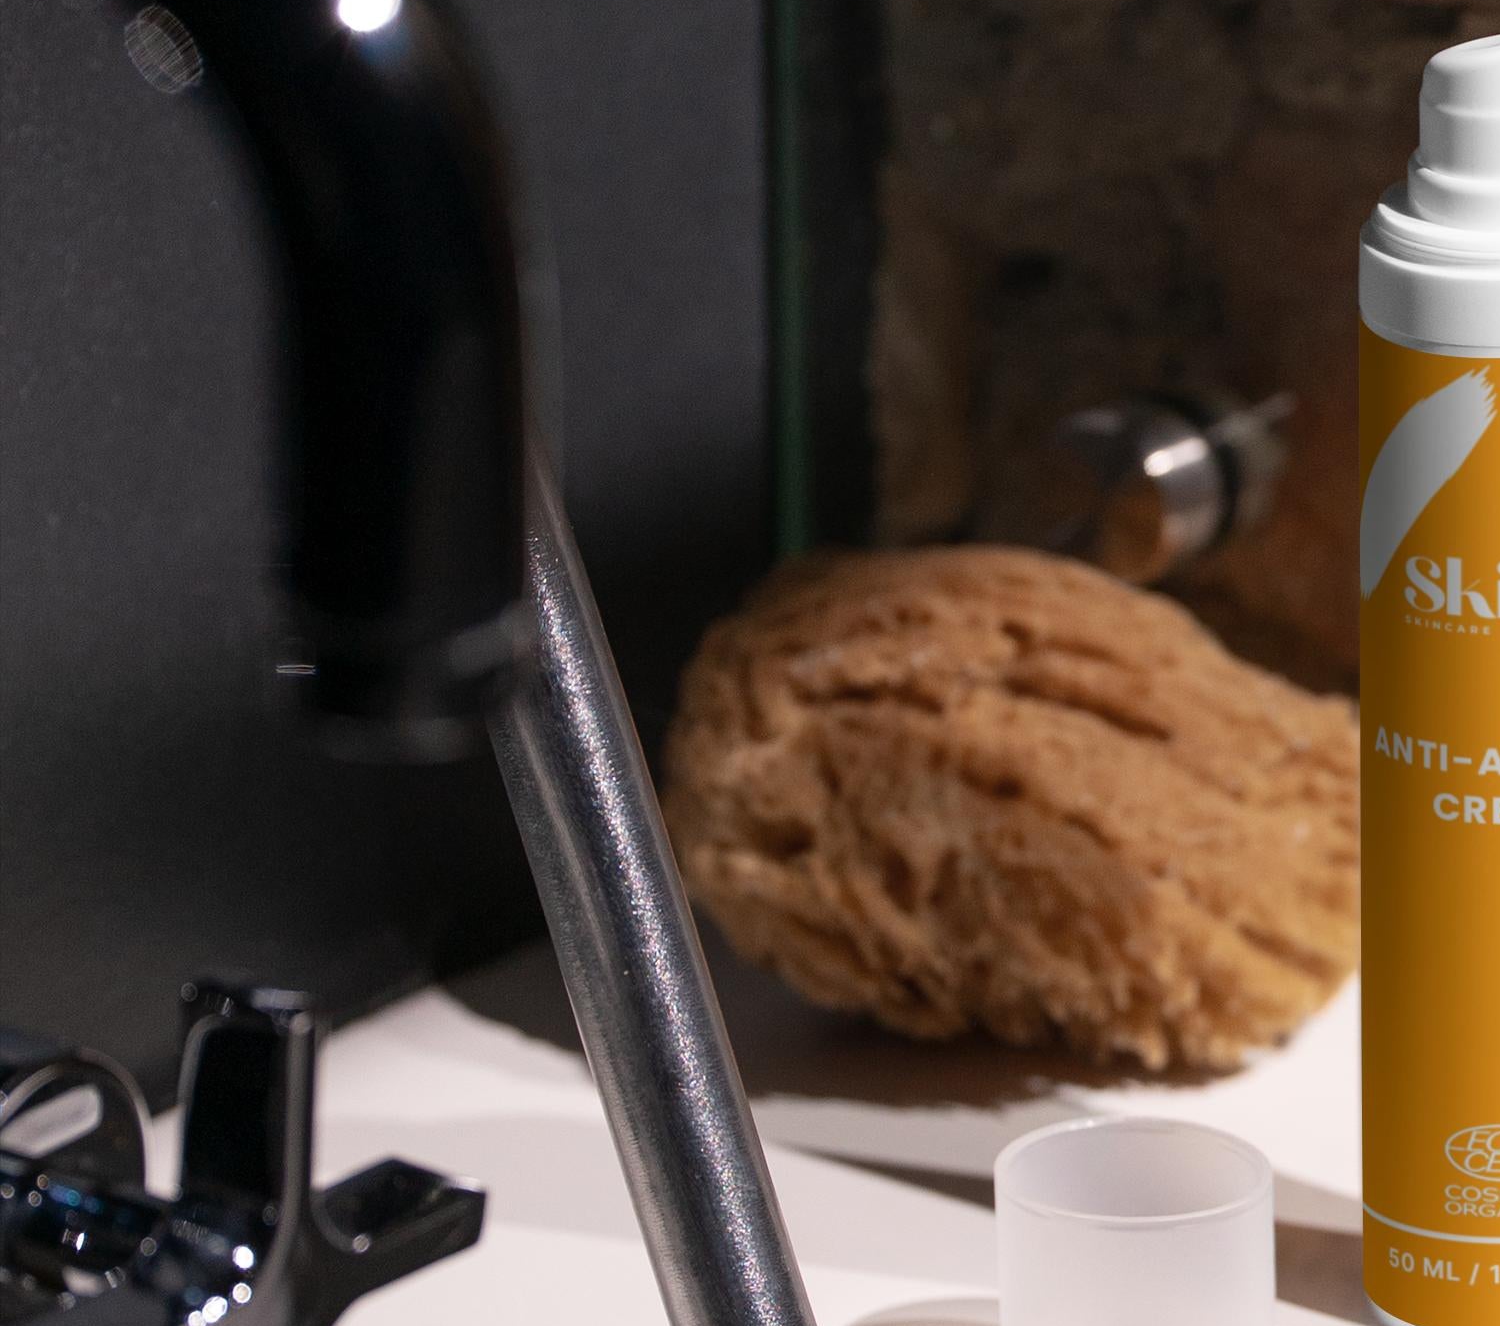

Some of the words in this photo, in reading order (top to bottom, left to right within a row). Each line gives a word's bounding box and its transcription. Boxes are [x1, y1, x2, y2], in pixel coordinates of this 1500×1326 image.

[1405, 614, 1491, 635] SKINCARE
[1388, 1247, 1415, 1273] 50
[1423, 1257, 1461, 1282] ML
[1469, 1263, 1480, 1286] /
